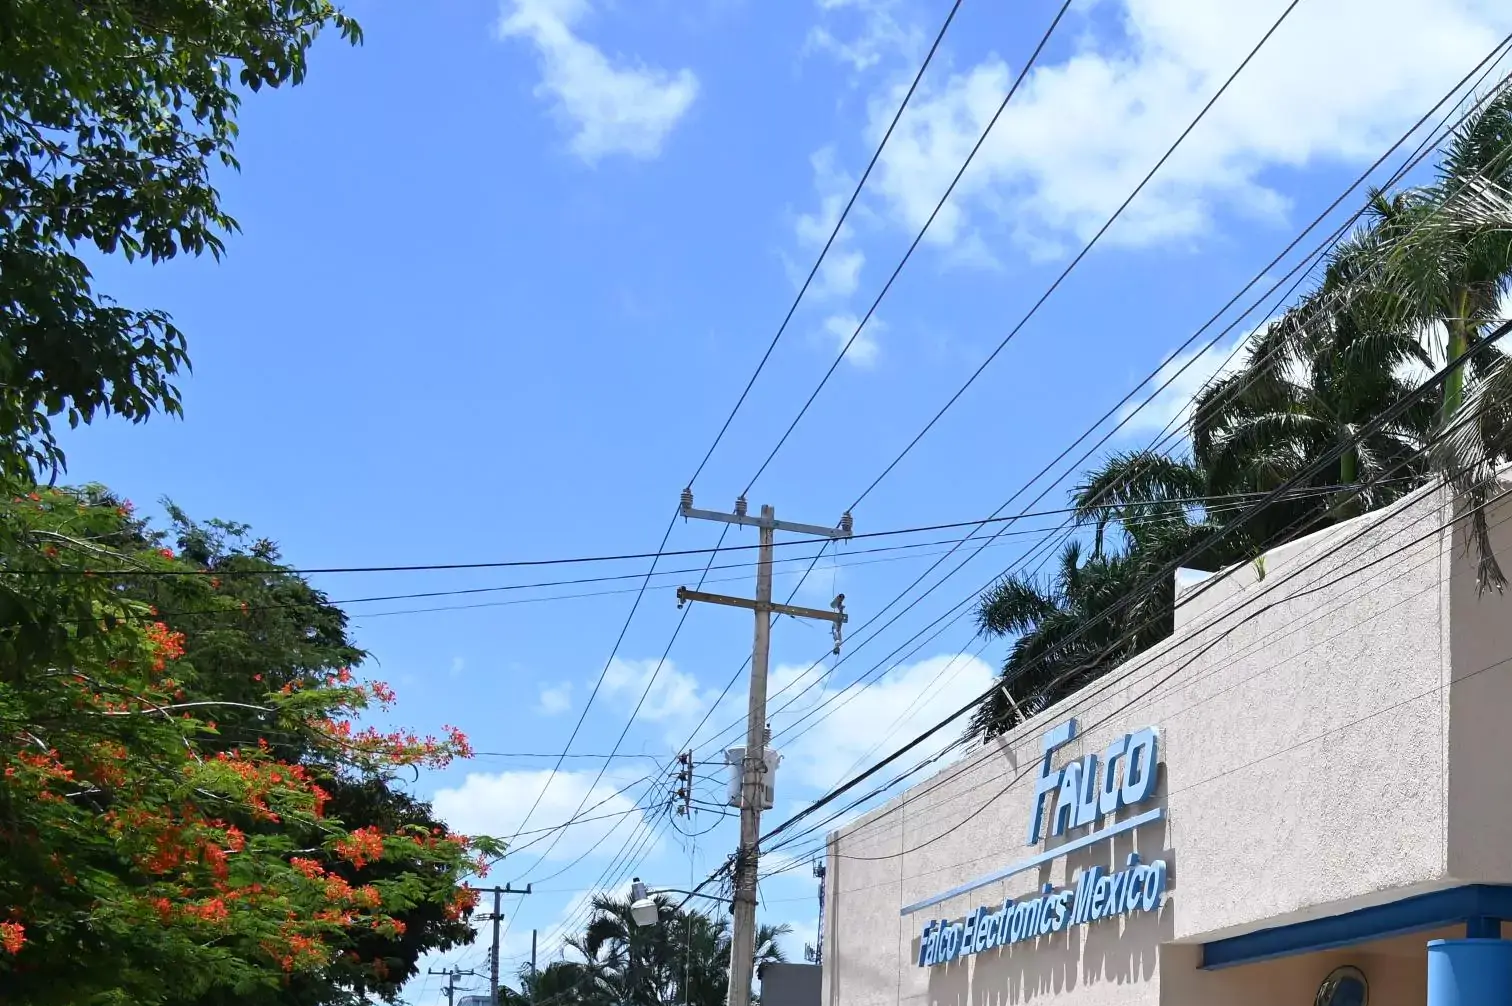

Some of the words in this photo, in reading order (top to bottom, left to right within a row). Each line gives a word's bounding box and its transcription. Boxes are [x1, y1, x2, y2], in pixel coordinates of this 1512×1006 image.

[1027, 717, 1160, 846] FALCO
[917, 919, 963, 967] Falco
[960, 882, 1073, 955] Electronics
[1070, 853, 1167, 926] Mexico
